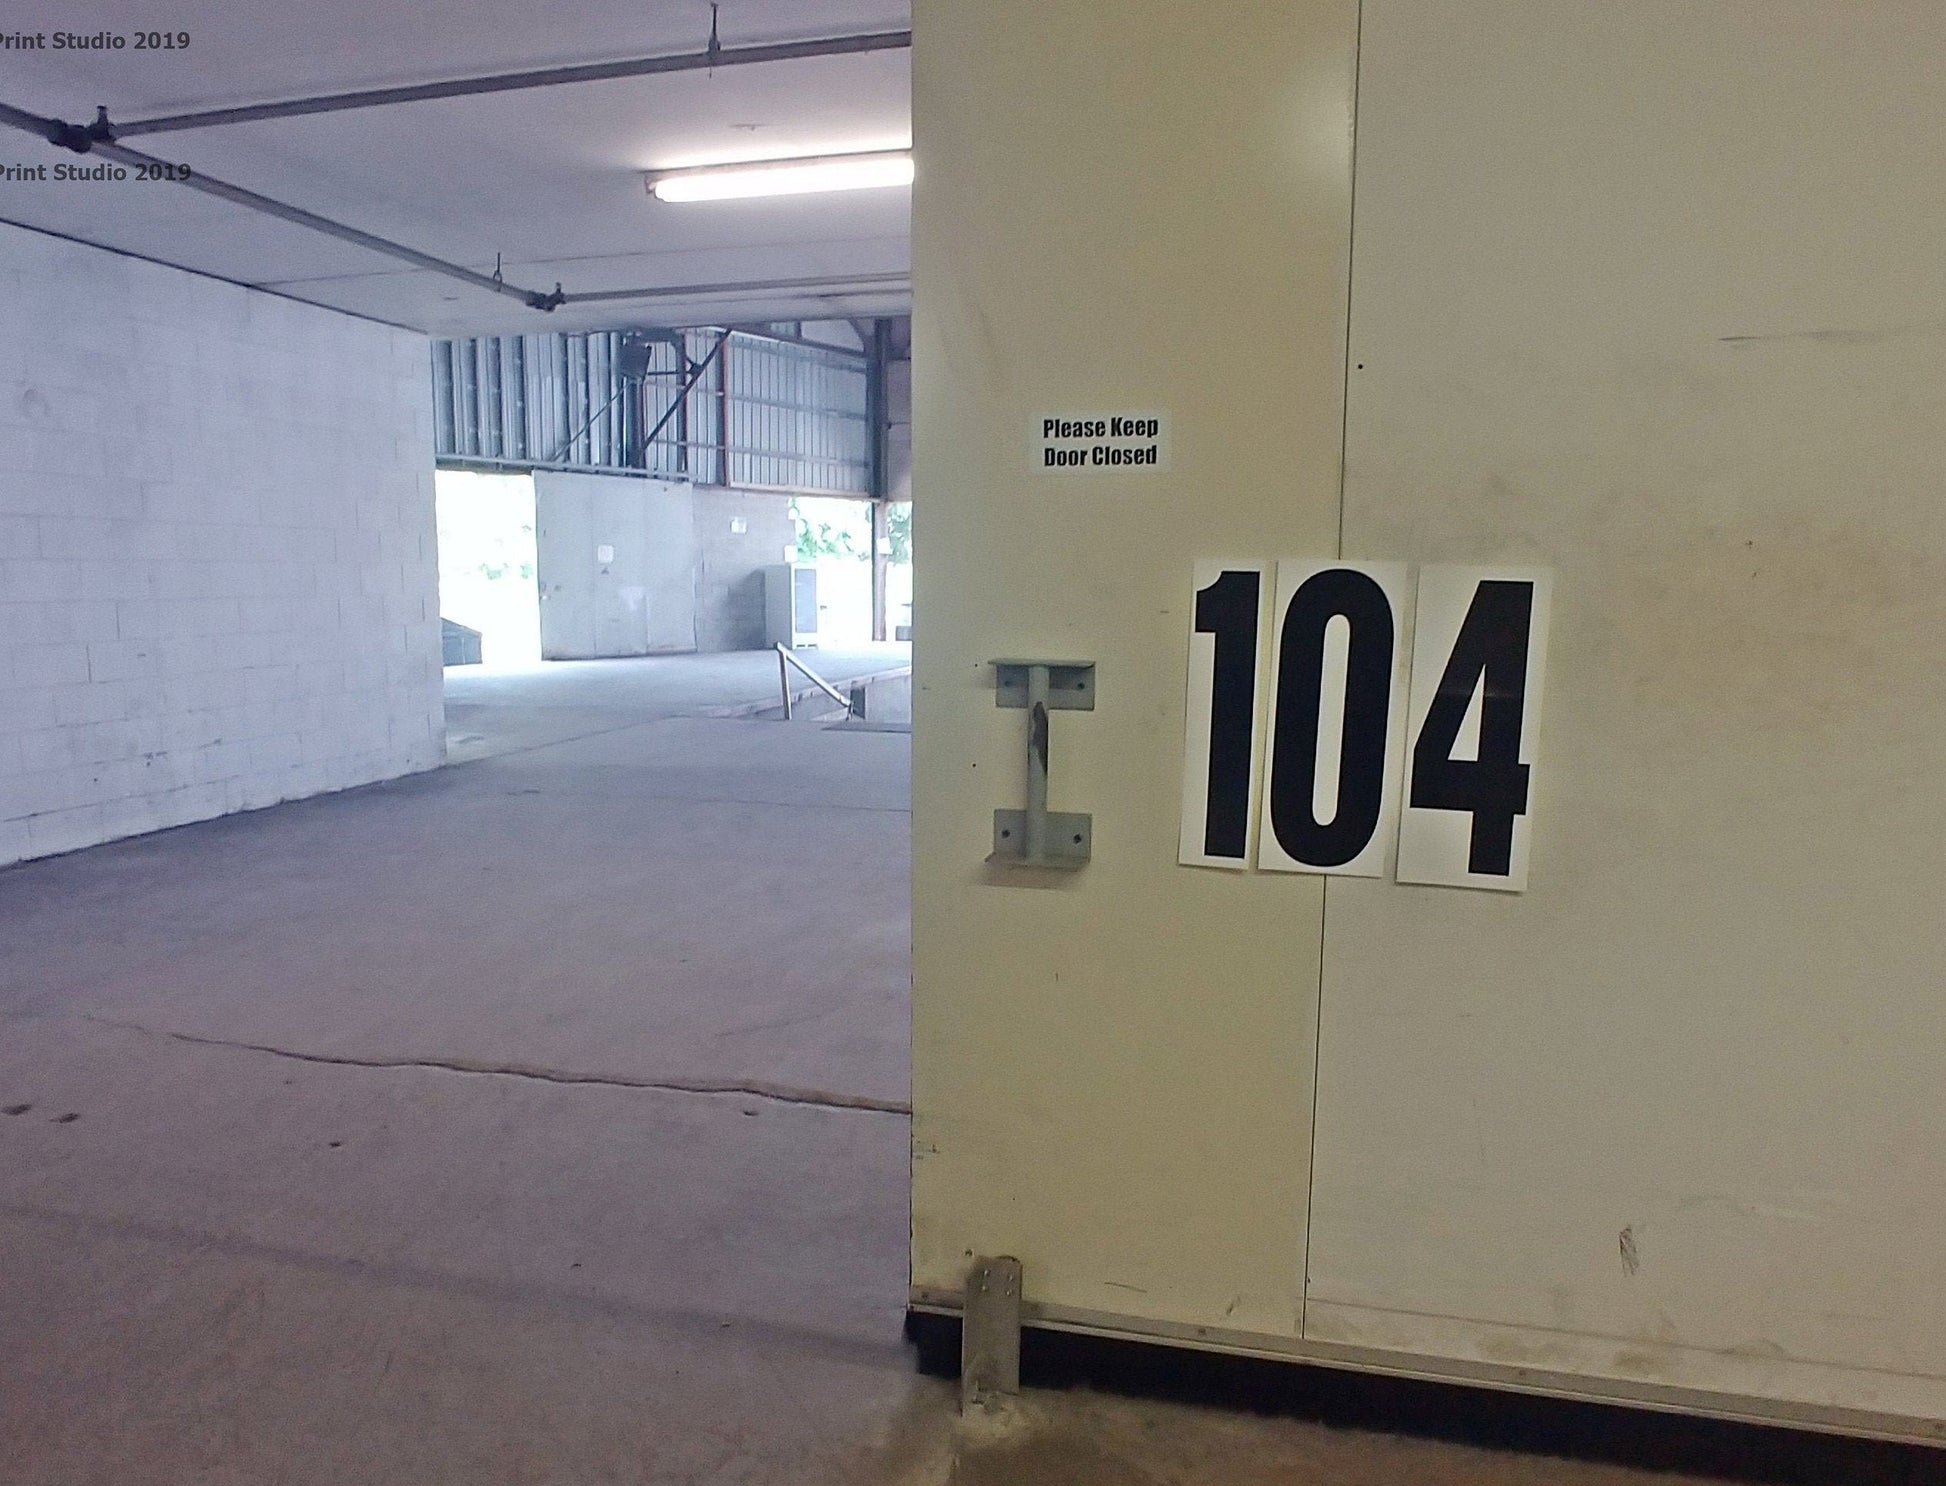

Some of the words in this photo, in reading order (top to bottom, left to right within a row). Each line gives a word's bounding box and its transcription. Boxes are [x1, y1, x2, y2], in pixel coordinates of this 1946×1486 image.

[1043, 418, 1106, 438] Please
[1110, 417, 1159, 438] Keep
[1044, 447, 1088, 467] Door
[1092, 445, 1157, 466] Closed
[1195, 568, 1534, 876] 104
